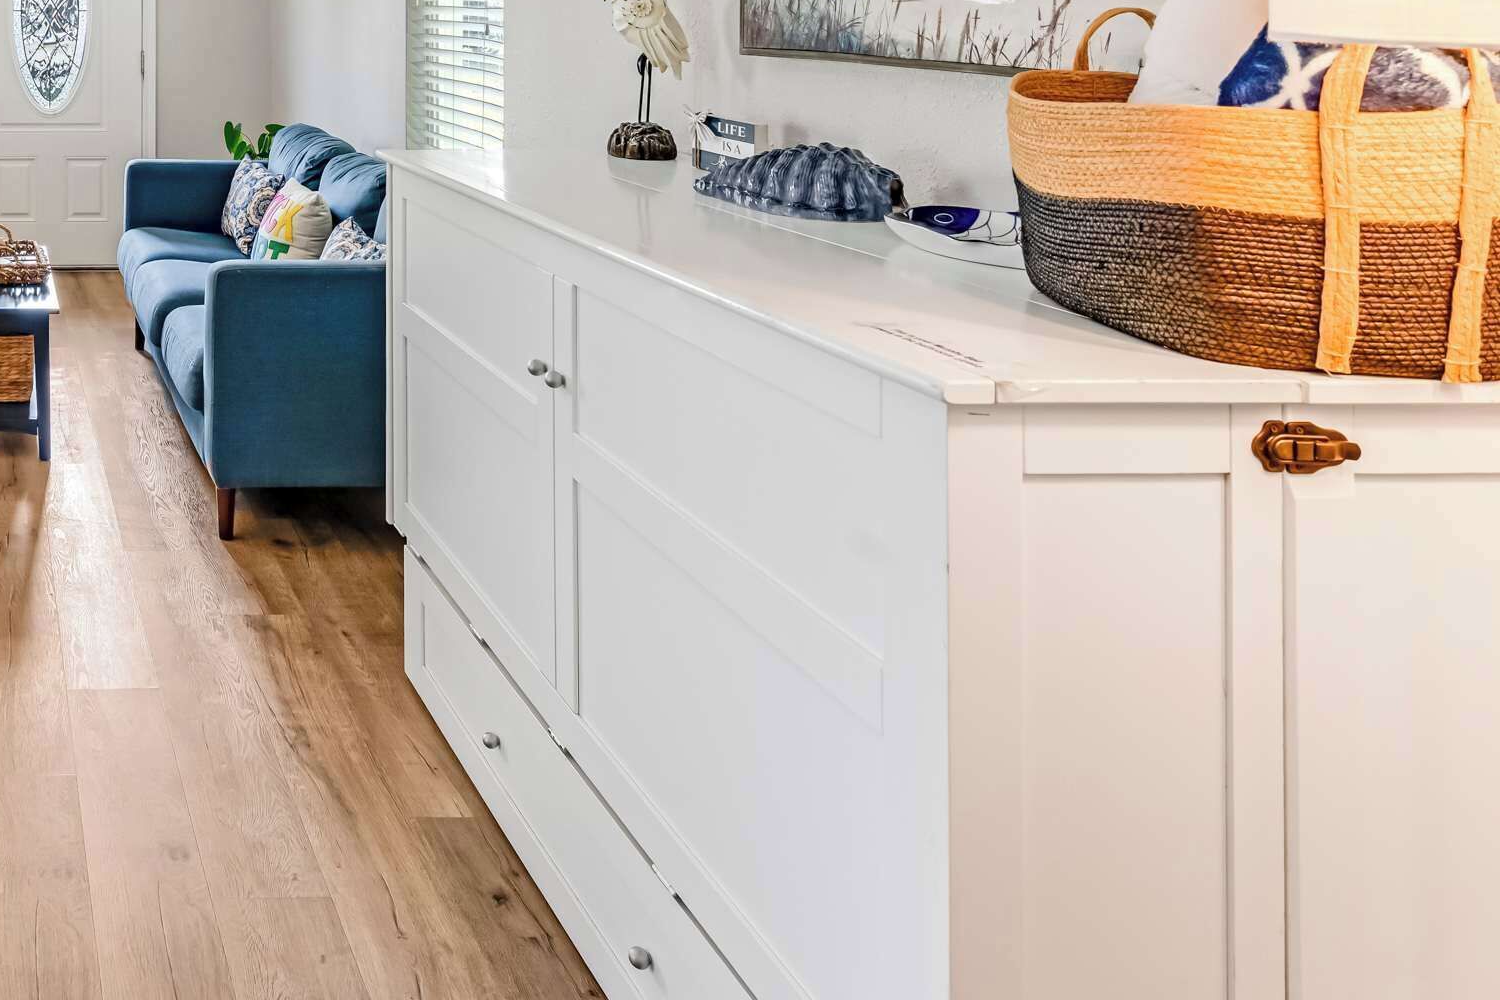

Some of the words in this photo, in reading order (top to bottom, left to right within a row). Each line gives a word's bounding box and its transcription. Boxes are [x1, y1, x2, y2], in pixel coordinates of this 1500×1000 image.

[717, 121, 746, 138] LIFE
[722, 140, 732, 153] IS
[734, 143, 741, 155] A
